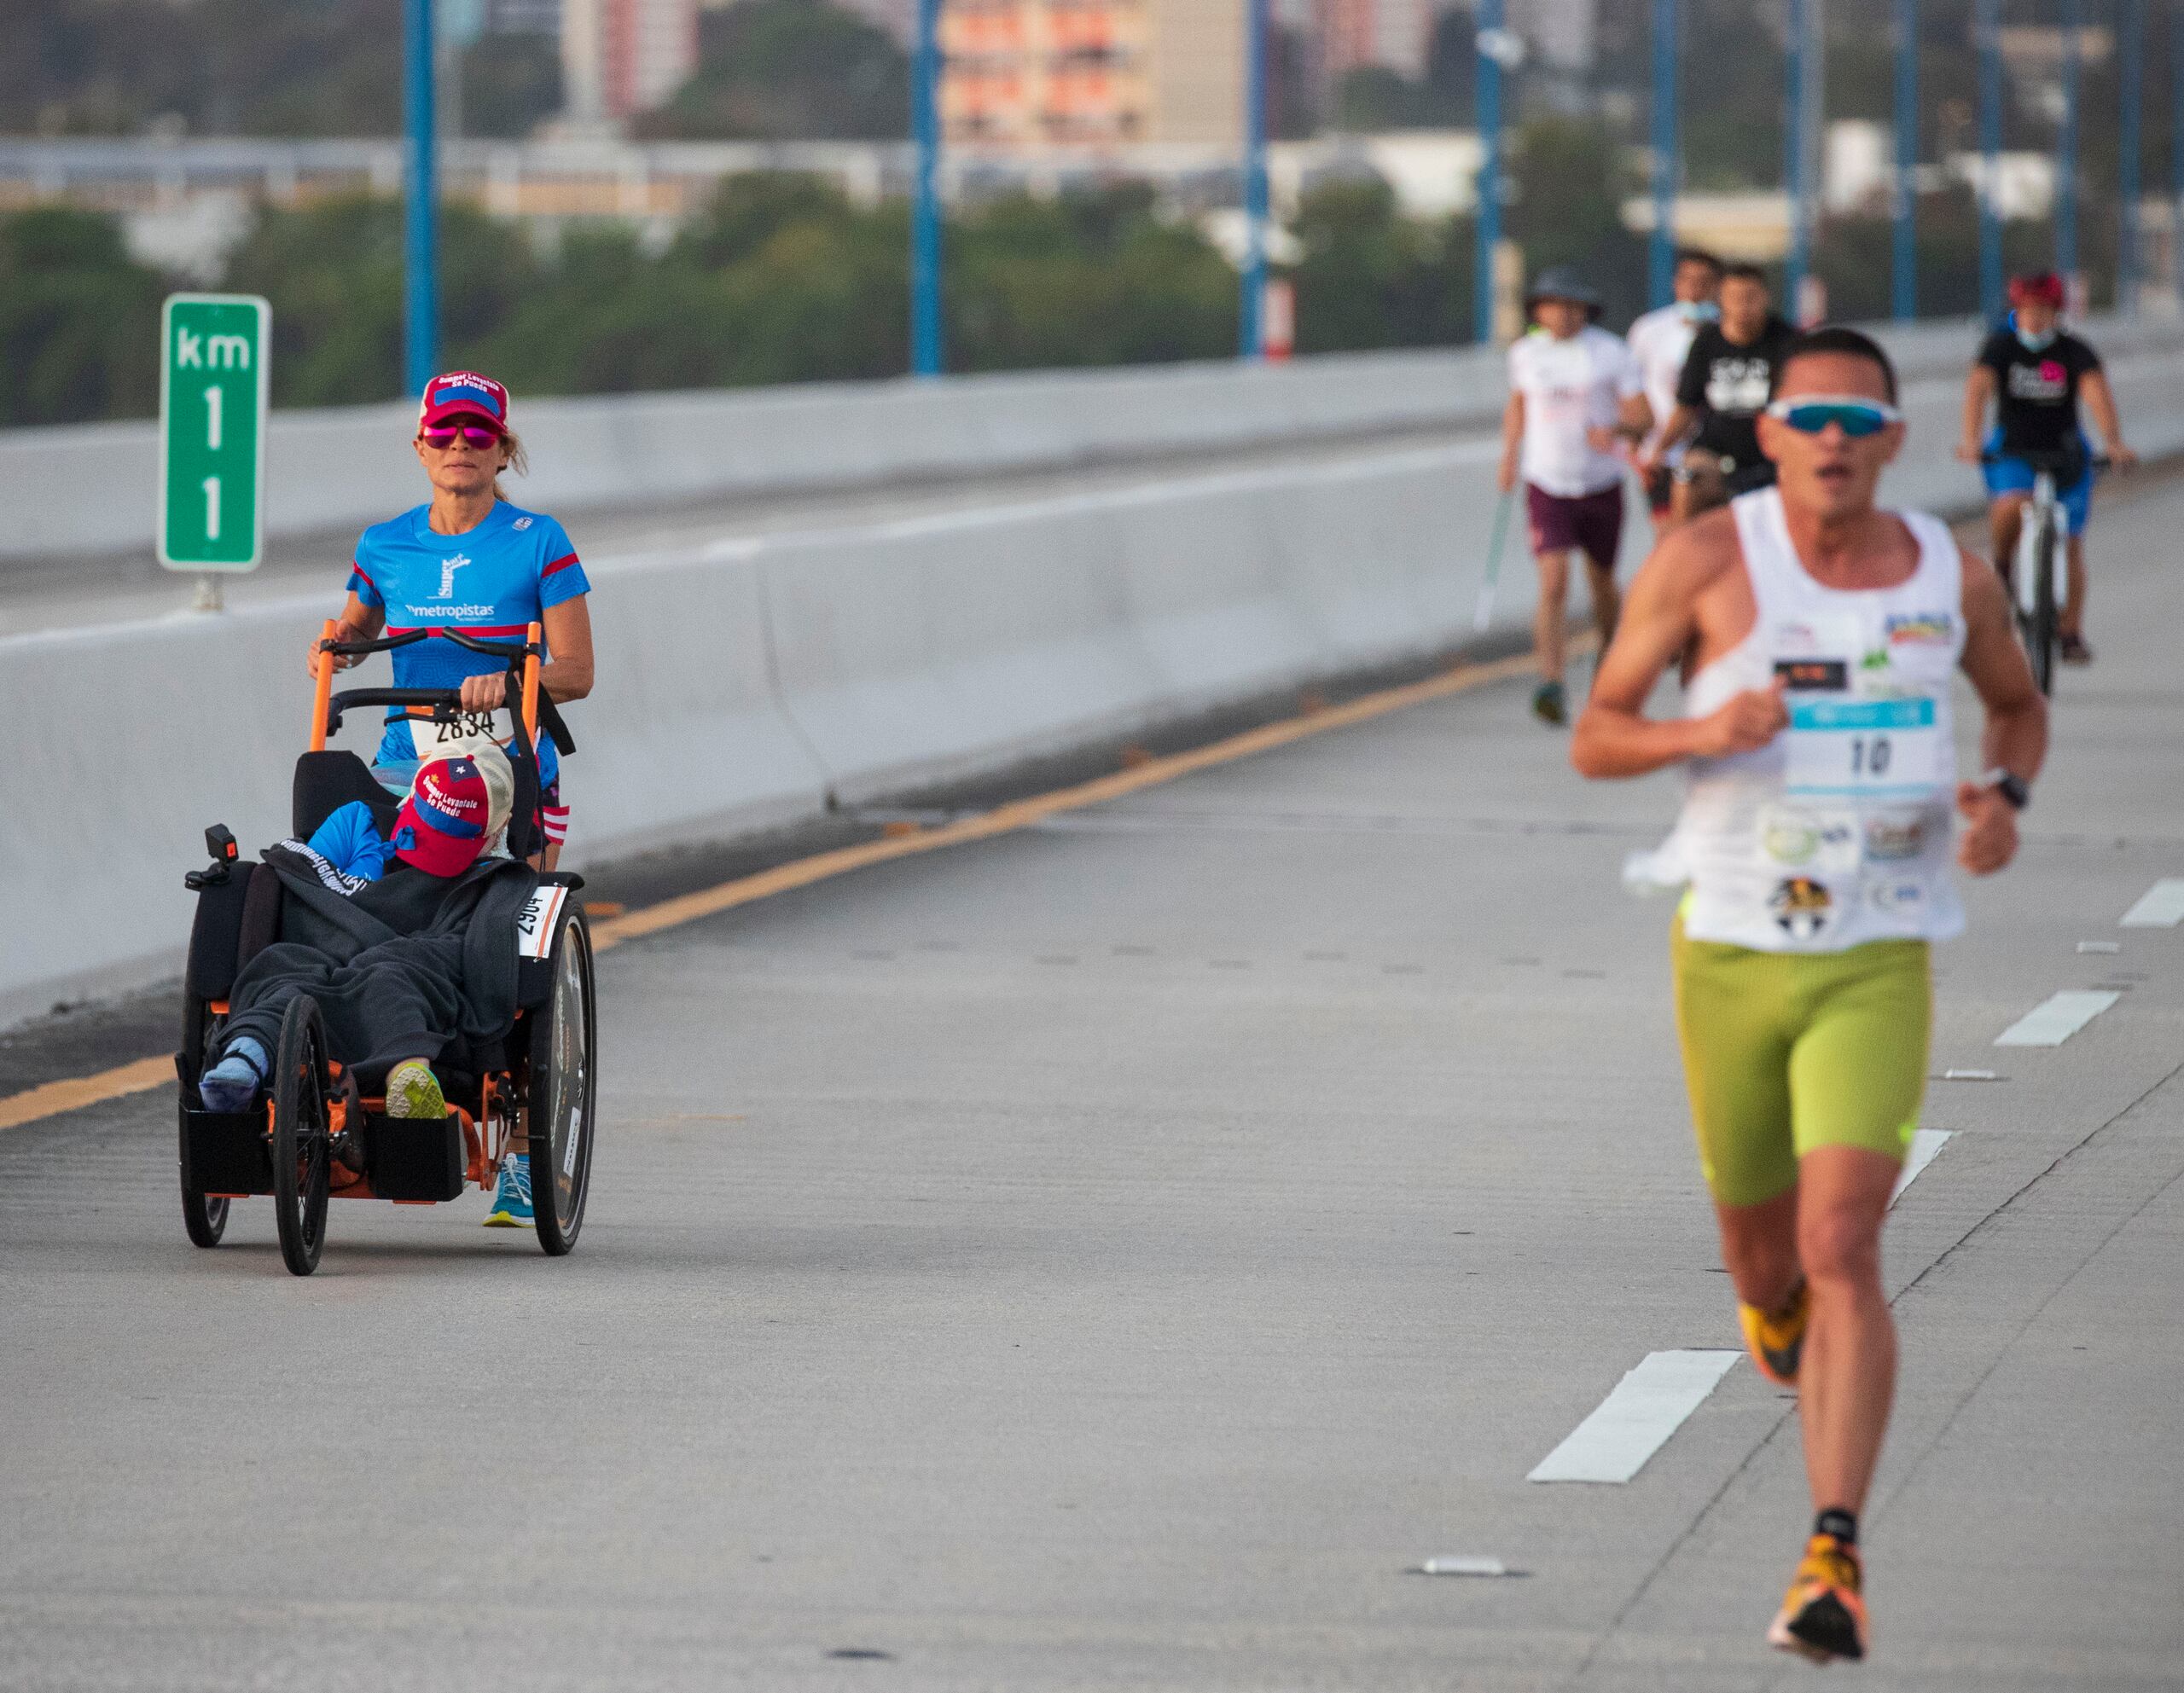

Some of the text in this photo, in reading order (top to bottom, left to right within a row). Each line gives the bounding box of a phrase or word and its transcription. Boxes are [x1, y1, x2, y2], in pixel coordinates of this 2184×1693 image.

[177, 327, 250, 369] km
[205, 386, 224, 449] 1
[203, 477, 221, 540] 1
[413, 603, 494, 621] metropistas
[434, 712, 495, 743] 2834
[1853, 737, 1891, 774] 10
